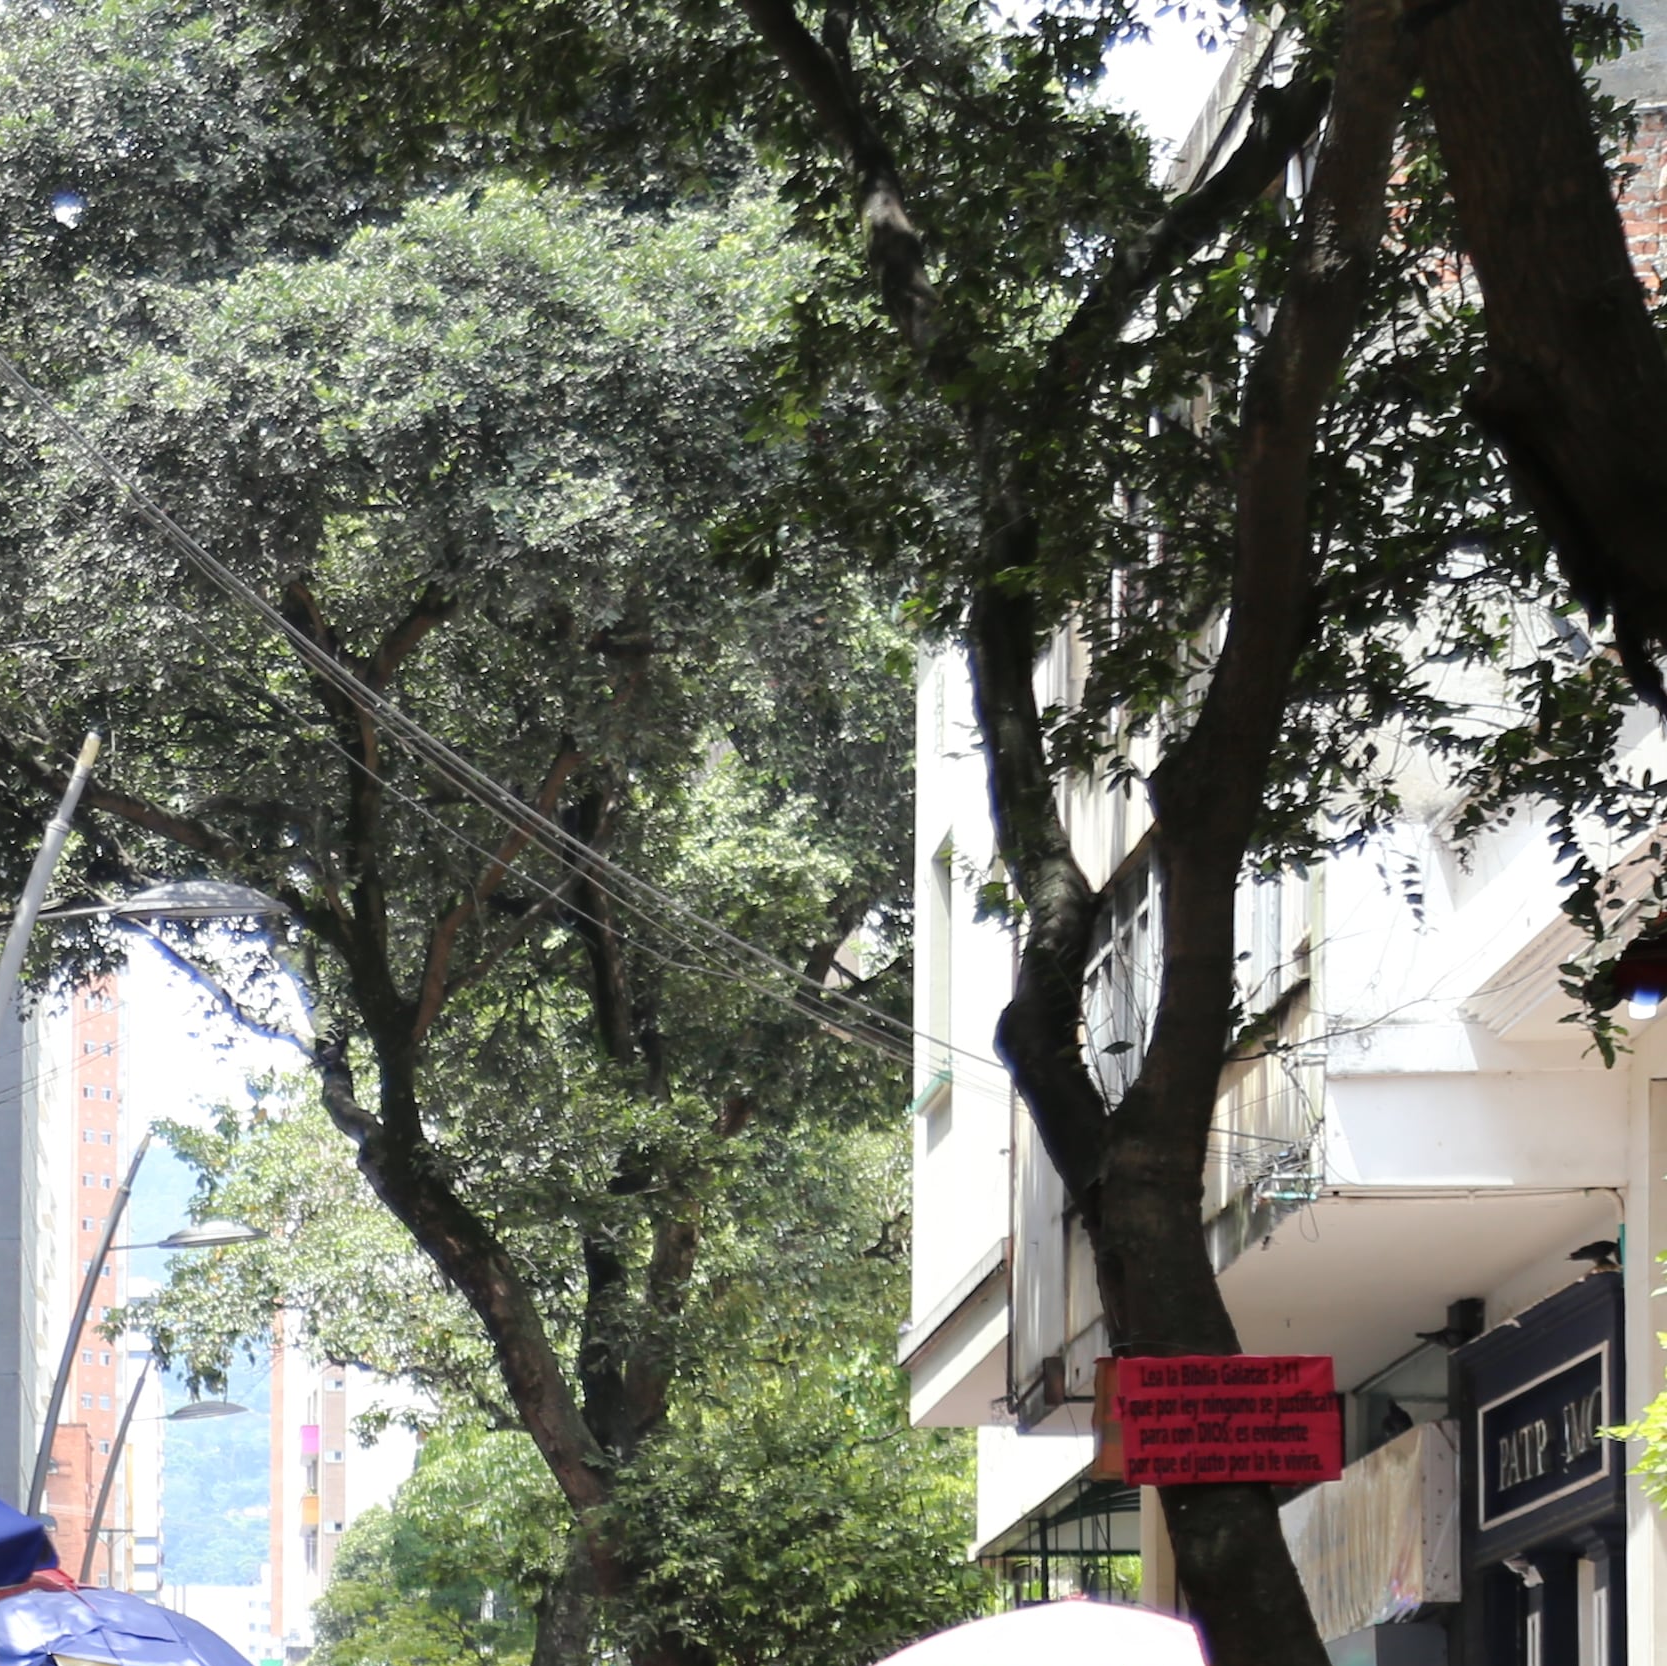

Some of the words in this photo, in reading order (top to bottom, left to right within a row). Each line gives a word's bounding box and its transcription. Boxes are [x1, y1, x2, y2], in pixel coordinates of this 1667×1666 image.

[1130, 1399, 1153, 1421] que
[1157, 1398, 1179, 1421] por
[1181, 1394, 1198, 1421] ley
[1259, 1397, 1274, 1413] se
[1128, 1455, 1149, 1479] por
[1153, 1455, 1178, 1479] que
[1229, 1454, 1251, 1479] por
